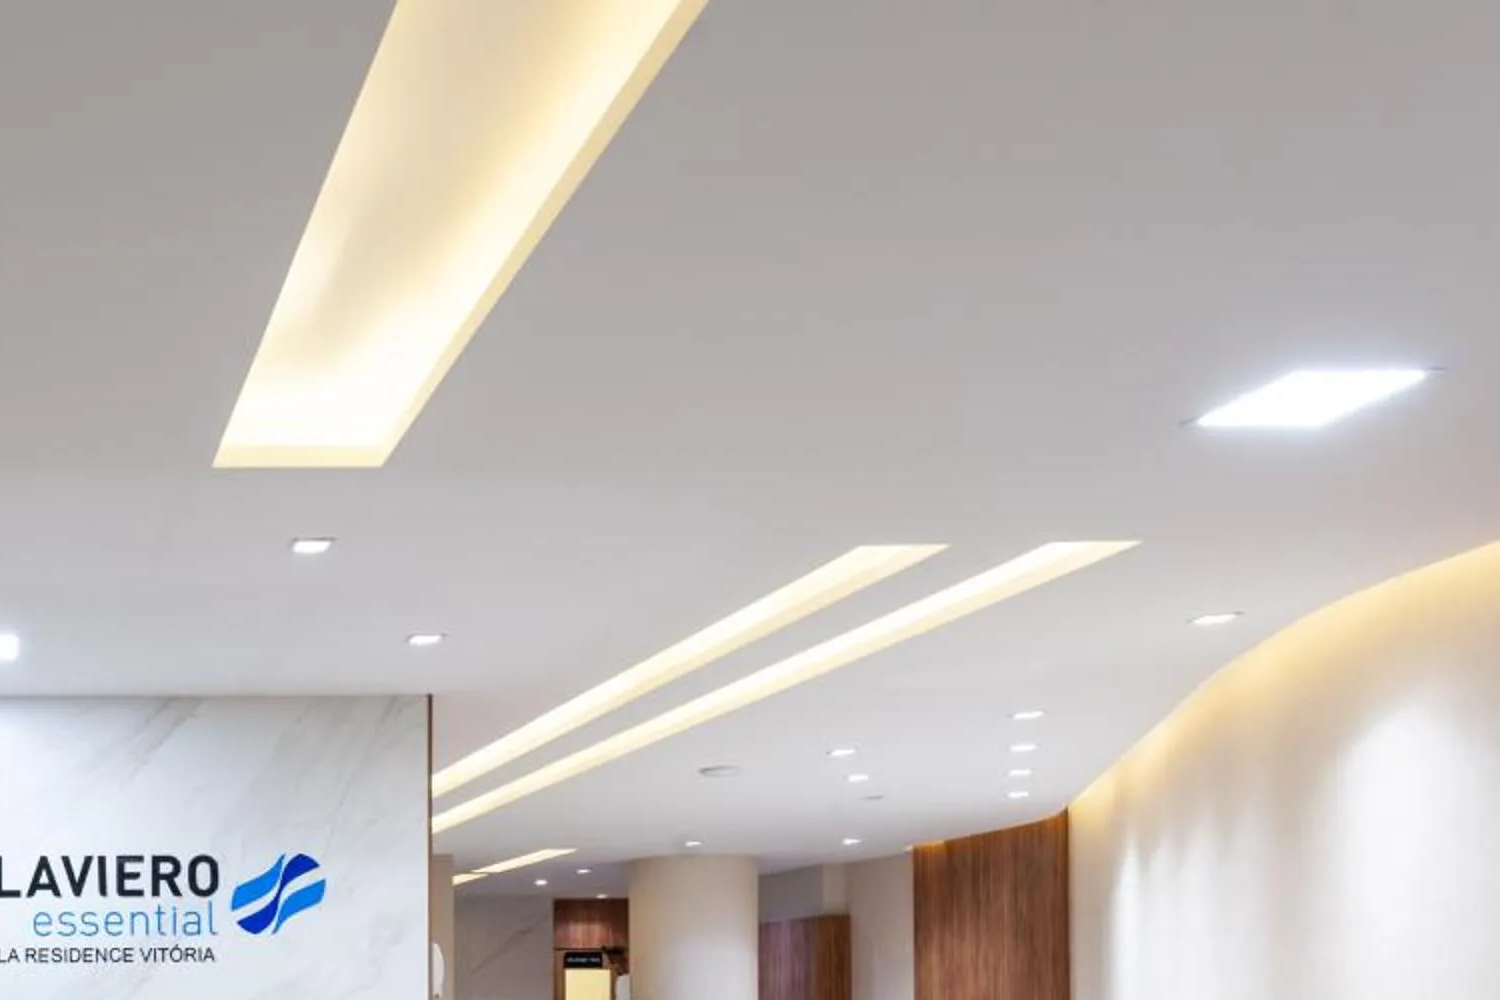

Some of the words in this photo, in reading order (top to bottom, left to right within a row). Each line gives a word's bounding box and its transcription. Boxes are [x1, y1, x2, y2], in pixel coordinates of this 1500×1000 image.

[33, 901, 218, 937] essential
[25, 947, 134, 963] RESIDENCE
[140, 944, 215, 963] VITÓRIA
